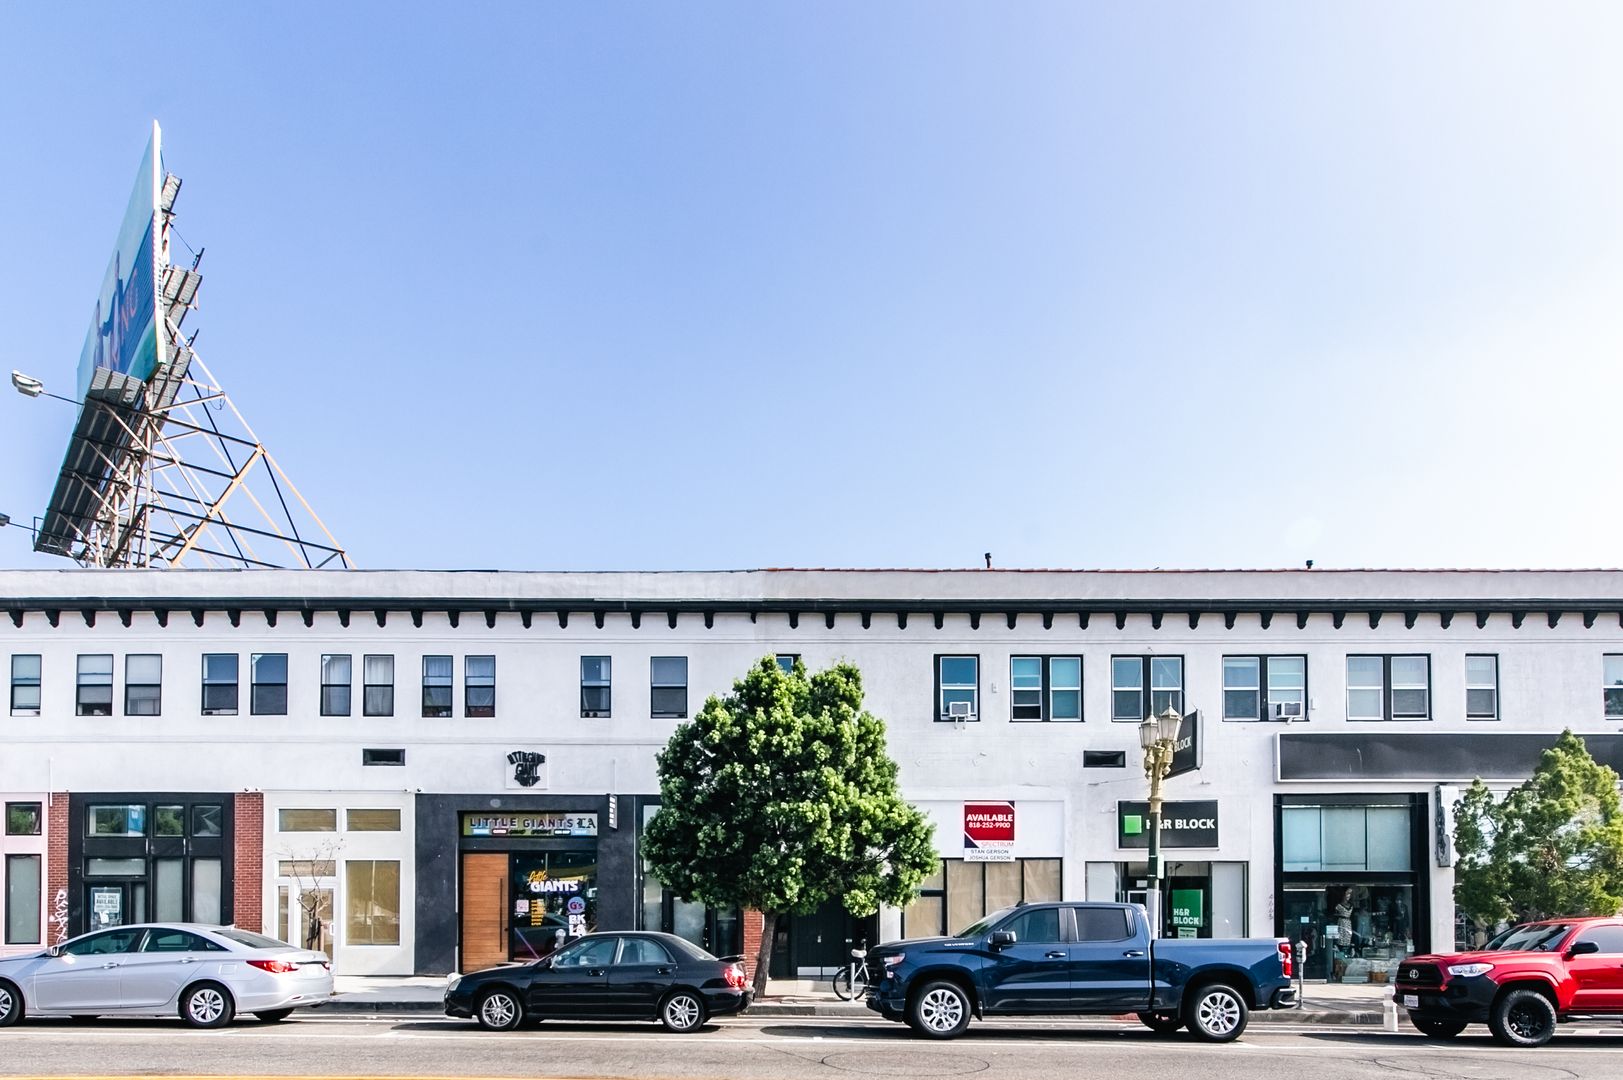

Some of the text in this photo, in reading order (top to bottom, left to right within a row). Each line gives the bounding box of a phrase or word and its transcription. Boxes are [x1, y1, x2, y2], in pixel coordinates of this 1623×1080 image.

[470, 817, 517, 828] LITTLE
[523, 818, 574, 829] GIANTS
[1175, 819, 1216, 829] BLOCK
[530, 880, 579, 892] GIANTS
[1173, 908, 1190, 916] H&R
[569, 914, 586, 925] BK
[1173, 916, 1200, 925] BLOCK
